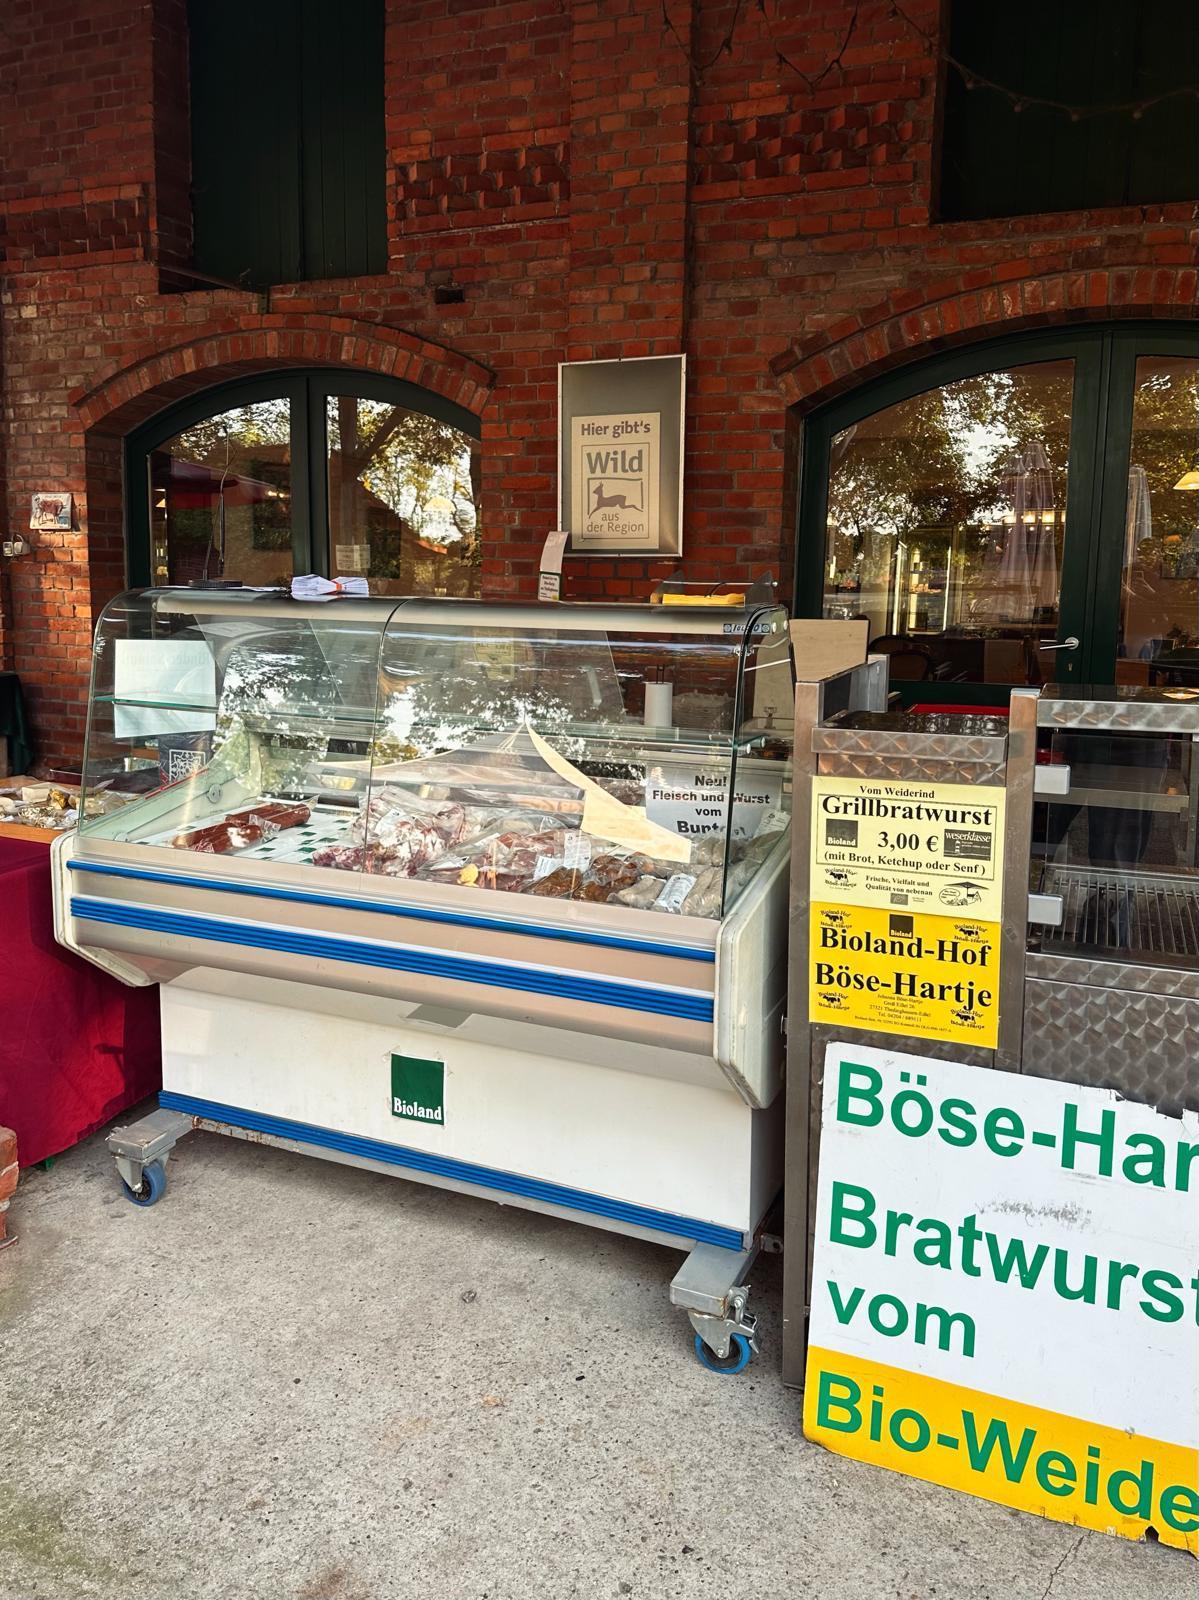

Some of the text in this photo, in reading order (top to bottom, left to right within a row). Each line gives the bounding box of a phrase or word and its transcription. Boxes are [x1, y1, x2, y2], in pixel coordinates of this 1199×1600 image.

[581, 423, 609, 436] Hier
[586, 449, 643, 474] Wild
[601, 512, 620, 522] aus
[586, 522, 644, 535] der Region
[694, 775, 727, 787] Neu!
[652, 790, 697, 801] Fleisch
[701, 792, 724, 802] und
[859, 785, 935, 799] Vom Weiderind
[695, 808, 722, 817] vom
[822, 795, 992, 826] Grillbratwurst
[827, 837, 856, 847] Bioland
[877, 831, 920, 851] 3,00
[926, 835, 939, 852] €
[945, 831, 991, 843] weserklasse
[824, 852, 846, 862] (mit
[848, 853, 875, 865] Brot,
[878, 856, 923, 870] Ketchup
[925, 861, 951, 871] oder
[892, 877, 916, 886] Vielfalt
[917, 879, 930, 887] und
[865, 883, 892, 894] Qualität
[906, 887, 933, 896] nebenan
[890, 929, 913, 938] Bioland
[820, 926, 992, 967] Bioland-Hof
[815, 962, 992, 1011] Böse-Hartje
[393, 1096, 443, 1121] Bioland
[836, 1061, 1199, 1192] Böse-Har
[827, 1280, 976, 1358] vom
[816, 1371, 1199, 1533] Bio-Weide
